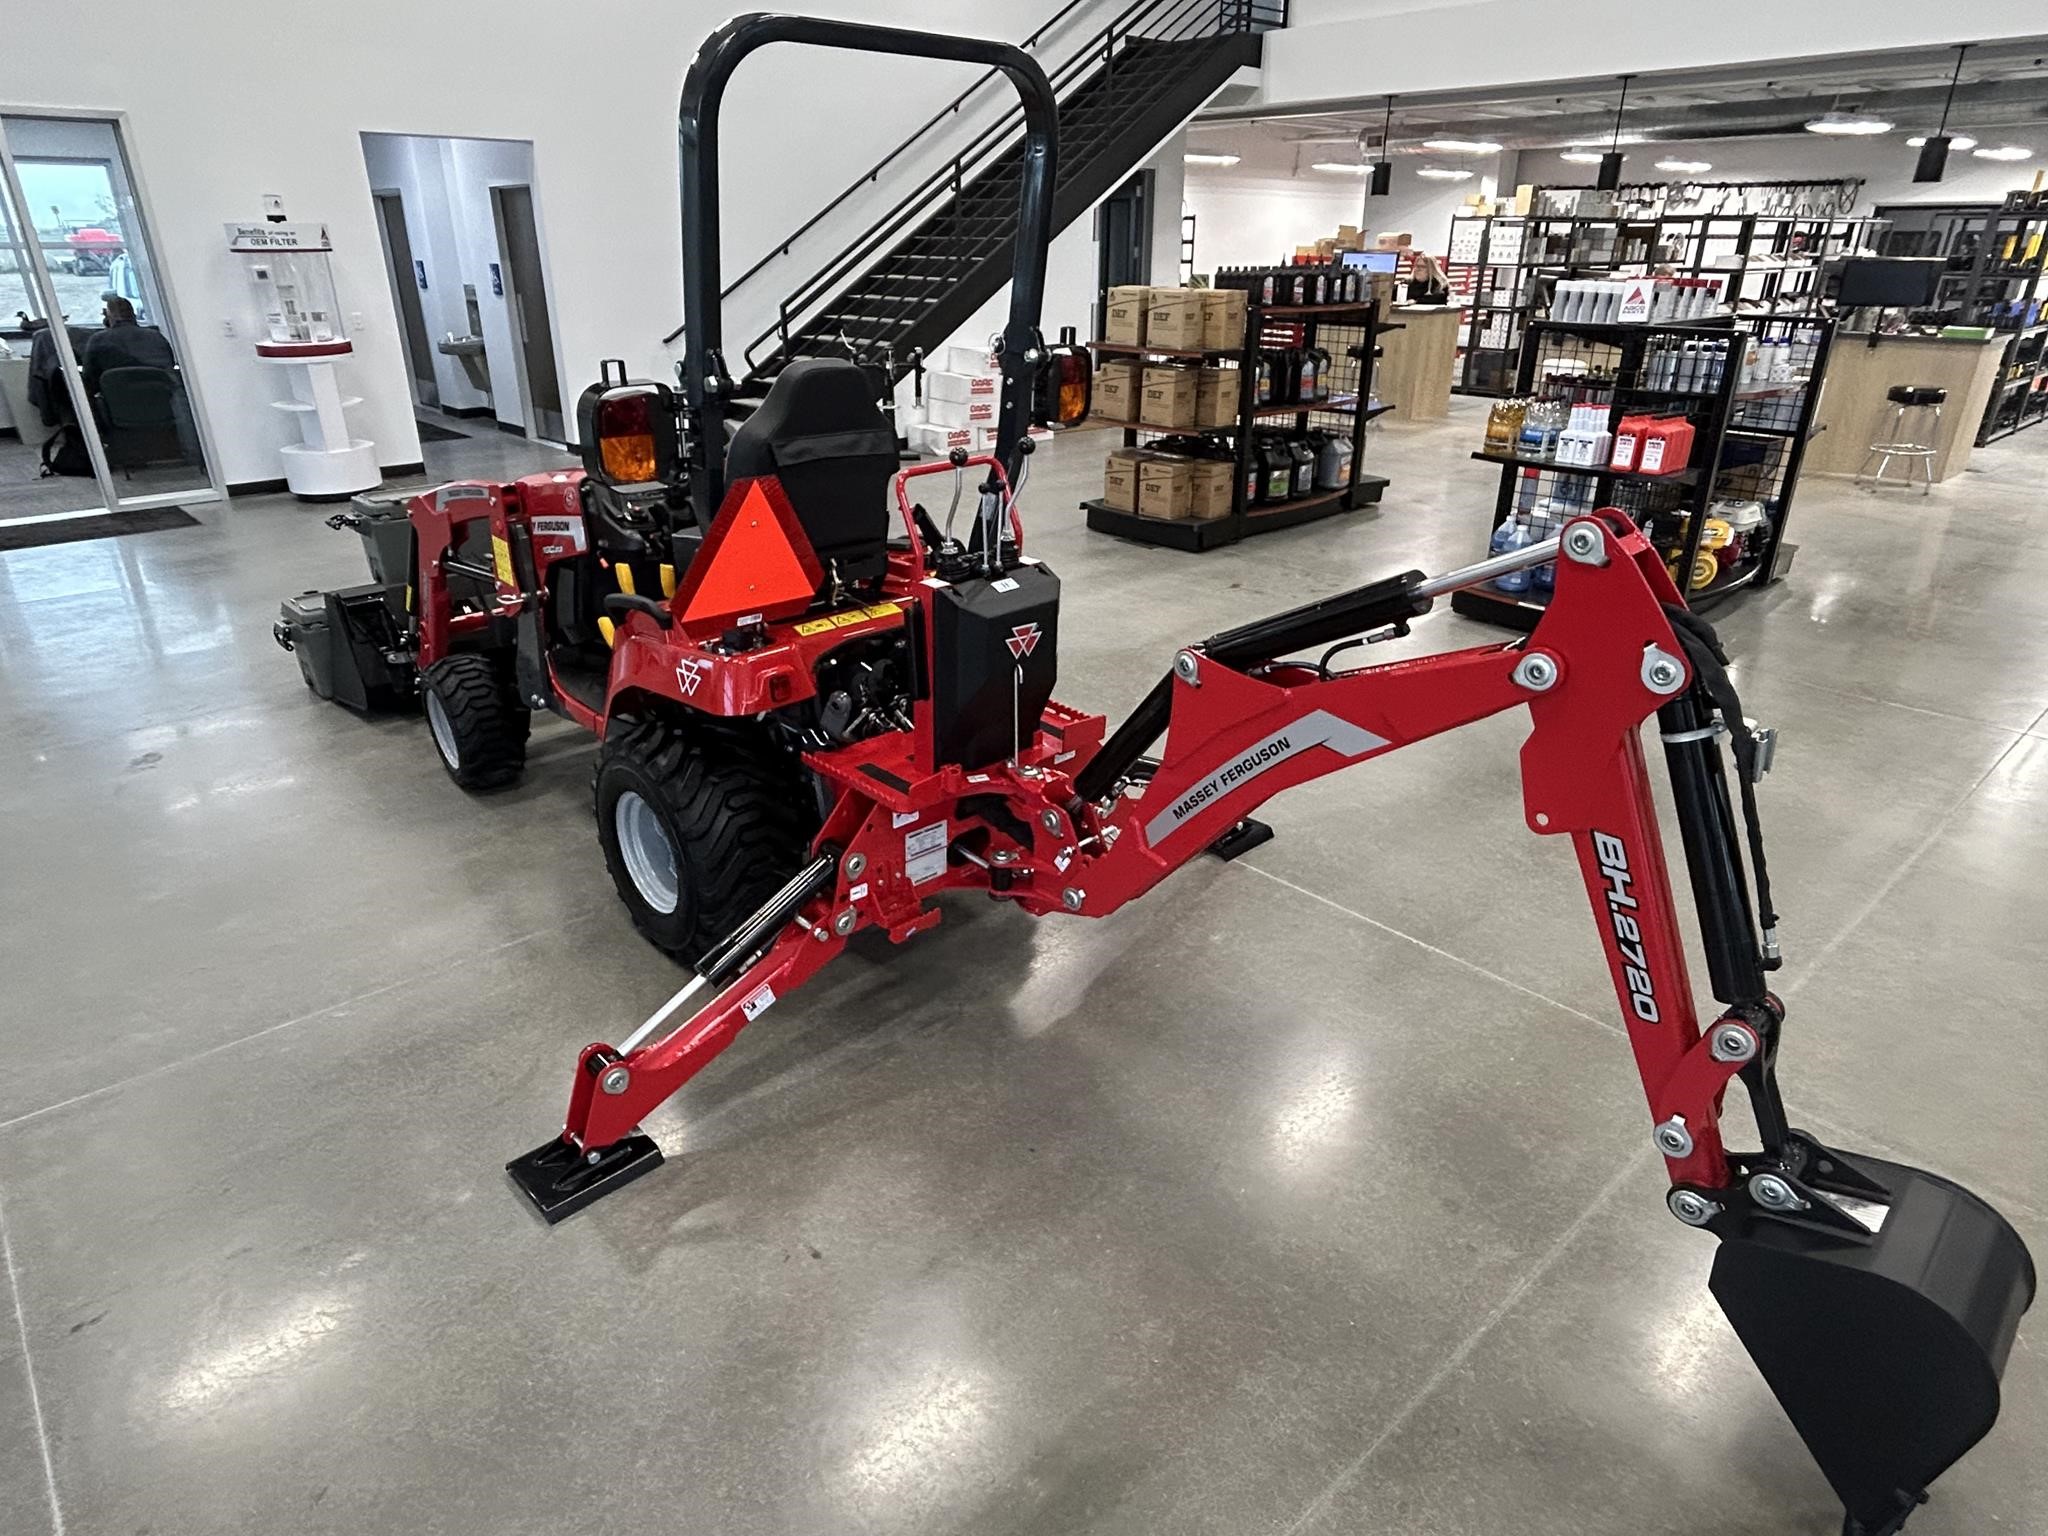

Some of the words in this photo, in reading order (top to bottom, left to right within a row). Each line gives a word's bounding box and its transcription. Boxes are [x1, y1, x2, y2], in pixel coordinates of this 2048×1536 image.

[250, 238, 268, 246] OEM
[269, 238, 298, 246] FILTER
[537, 521, 570, 532] FERGUSON
[1172, 780, 1220, 820] MASSEY
[1219, 736, 1291, 787] FERGUSON
[1592, 829, 1661, 1024] BH.2720
